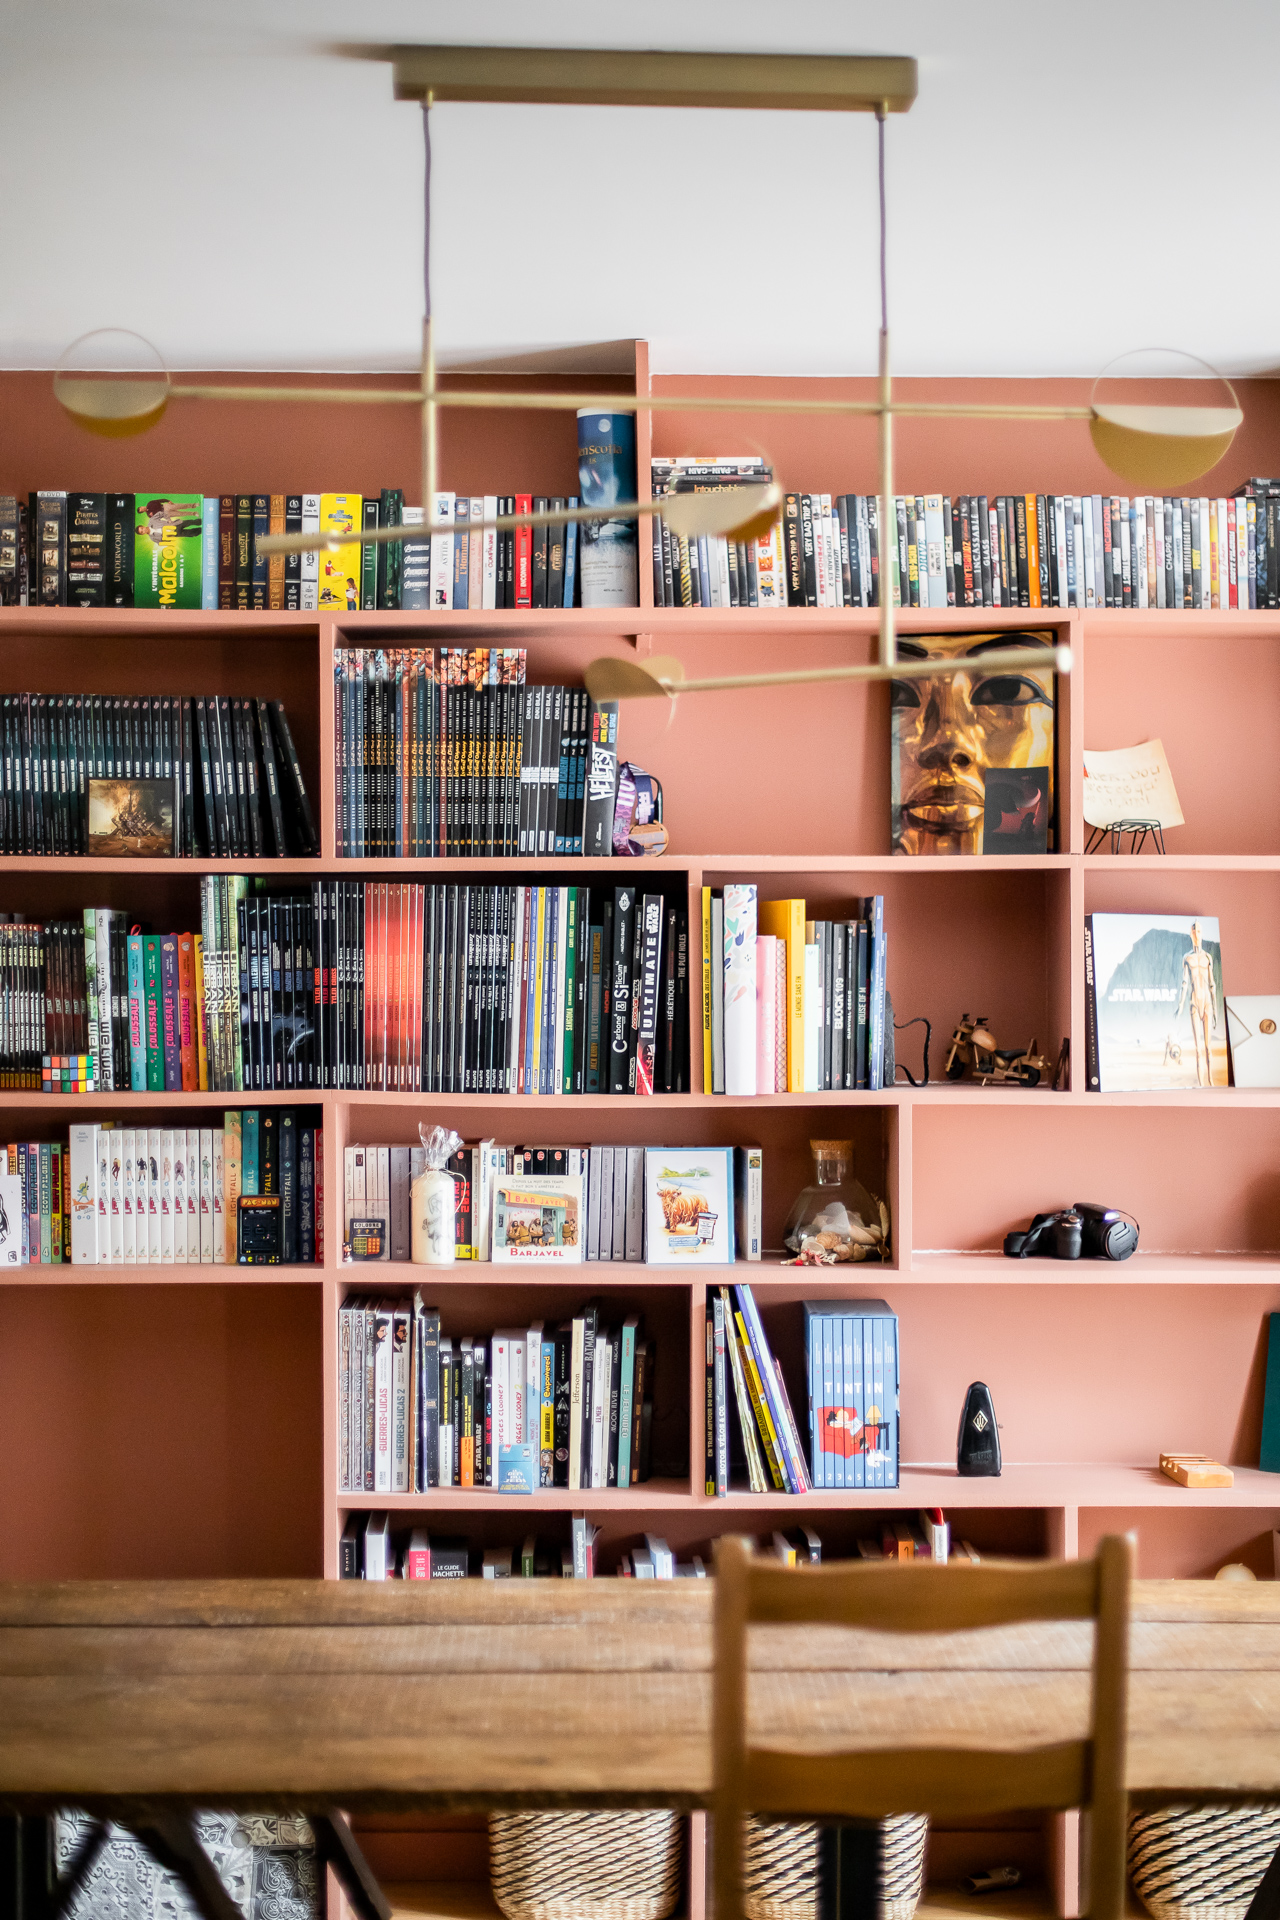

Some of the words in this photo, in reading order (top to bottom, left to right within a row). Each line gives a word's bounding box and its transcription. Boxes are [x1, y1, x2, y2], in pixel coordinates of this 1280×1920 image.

[694, 485, 746, 493] Intouchables
[803, 506, 811, 520] TRIP
[804, 521, 812, 537] BAD
[971, 514, 981, 573] INCASSABLE
[113, 522, 122, 582] UNDERWORLD
[459, 535, 468, 575] L'Homme
[663, 521, 672, 584] OBLIVION
[805, 538, 813, 556] VERY
[899, 535, 907, 573] CHRONICLE
[918, 538, 928, 572] DRIVE
[982, 539, 990, 566] GLASS
[1066, 529, 1074, 583] PROMETHEUS
[1165, 535, 1173, 570] CHAPPIE
[1192, 549, 1201, 569] FURY
[159, 525, 177, 604] Malcolm
[791, 555, 799, 571] BAD
[817, 535, 825, 594] EXPENDABLES
[908, 545, 918, 581] KICK-ASS
[962, 541, 973, 589] ZOMBIELAND
[608, 713, 617, 728] SPACE
[608, 729, 617, 743] METAL
[588, 742, 617, 801] HELLFEST
[651, 904, 659, 933] WARS
[216, 951, 224, 1013] URBAN
[230, 951, 239, 1013] URBAN
[250, 956, 259, 988] VALERIAN
[261, 956, 270, 988] VALERIAN
[643, 937, 657, 1028] ULTIMATE
[835, 977, 844, 992] 109
[1085, 957, 1093, 985] WARS
[120, 996, 128, 1017] INCOGNITO
[666, 979, 675, 1020] HÉRÉTIQUE
[858, 994, 866, 1002] OF
[1108, 989, 1143, 1002] STAR
[1143, 988, 1178, 1002] WARS
[148, 999, 159, 1049] COLOSSALE
[165, 998, 176, 1047] COLOSSALE
[181, 998, 191, 1047] COLOSSALE
[834, 993, 844, 1030] BLOCK
[858, 1004, 866, 1025] HOUSE
[590, 1042, 598, 1057] KIRBY
[590, 1058, 598, 1070] JACK
[510, 1248, 564, 1256] BARJAVEL
[584, 1330, 595, 1361] BATMAN
[543, 1355, 553, 1398] empowered
[572, 1373, 581, 1405] Jefferson
[622, 1384, 629, 1394] LE
[824, 1382, 883, 1394] TINTIN
[379, 1388, 388, 1413] LUCAS
[396, 1396, 405, 1420] LUCAS
[707, 1399, 713, 1407] DU
[379, 1417, 388, 1451] GUERRES
[610, 1409, 618, 1433] MOON
[717, 1424, 725, 1447] VÉLOS
[396, 1424, 405, 1459] GUERRES
